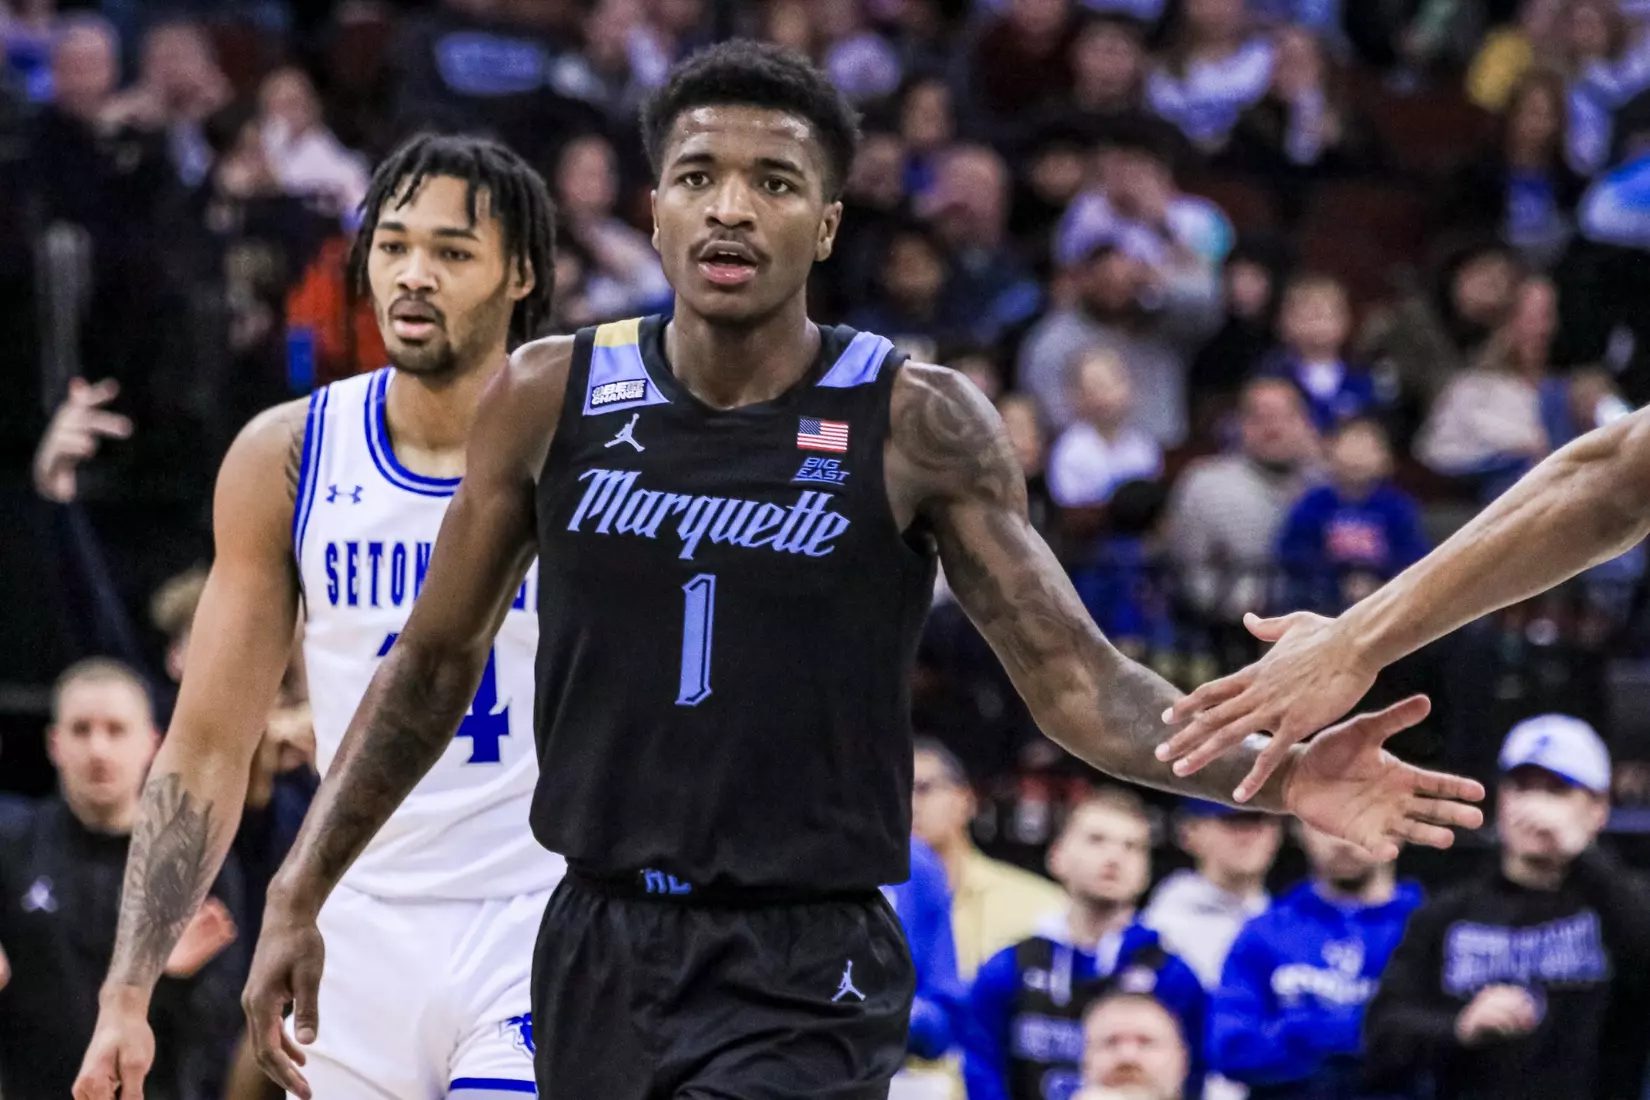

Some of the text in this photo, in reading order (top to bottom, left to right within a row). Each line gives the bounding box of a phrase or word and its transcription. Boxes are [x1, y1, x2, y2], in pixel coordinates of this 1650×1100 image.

[591, 389, 644, 405] CHANGE
[803, 457, 842, 470] BIG
[795, 467, 851, 481] EAST
[566, 468, 851, 560] Marquette
[674, 573, 717, 707] 1
